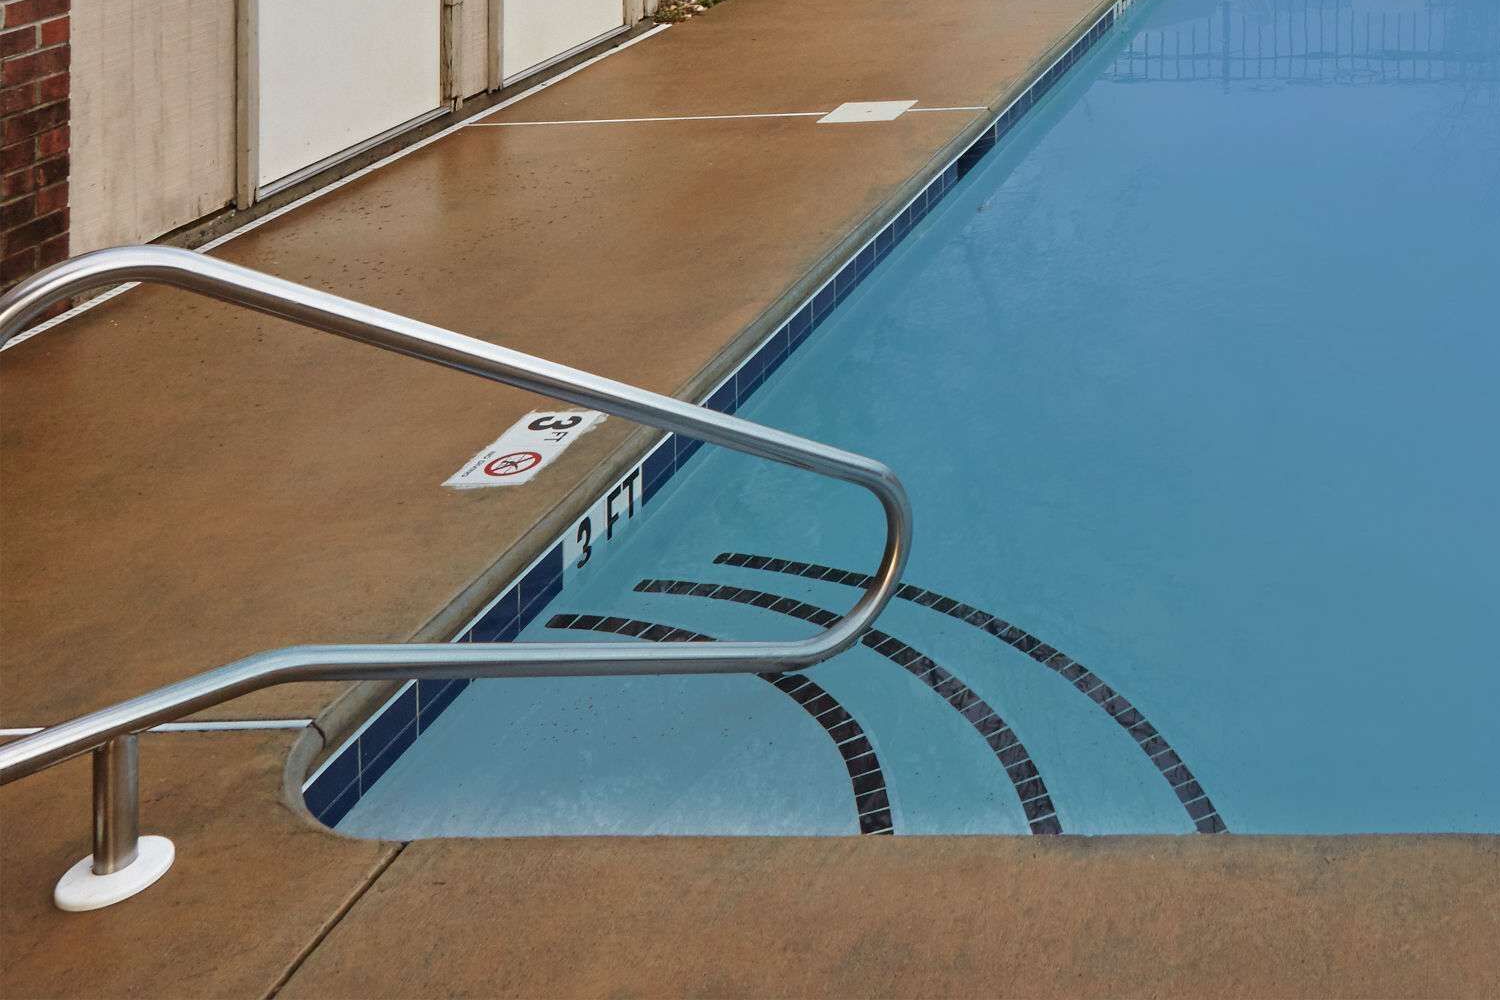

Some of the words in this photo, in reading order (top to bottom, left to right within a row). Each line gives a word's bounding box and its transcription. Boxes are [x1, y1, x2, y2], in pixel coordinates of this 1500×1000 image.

[528, 416, 582, 431] 3
[576, 516, 593, 569] 3
[607, 467, 640, 541] FT
